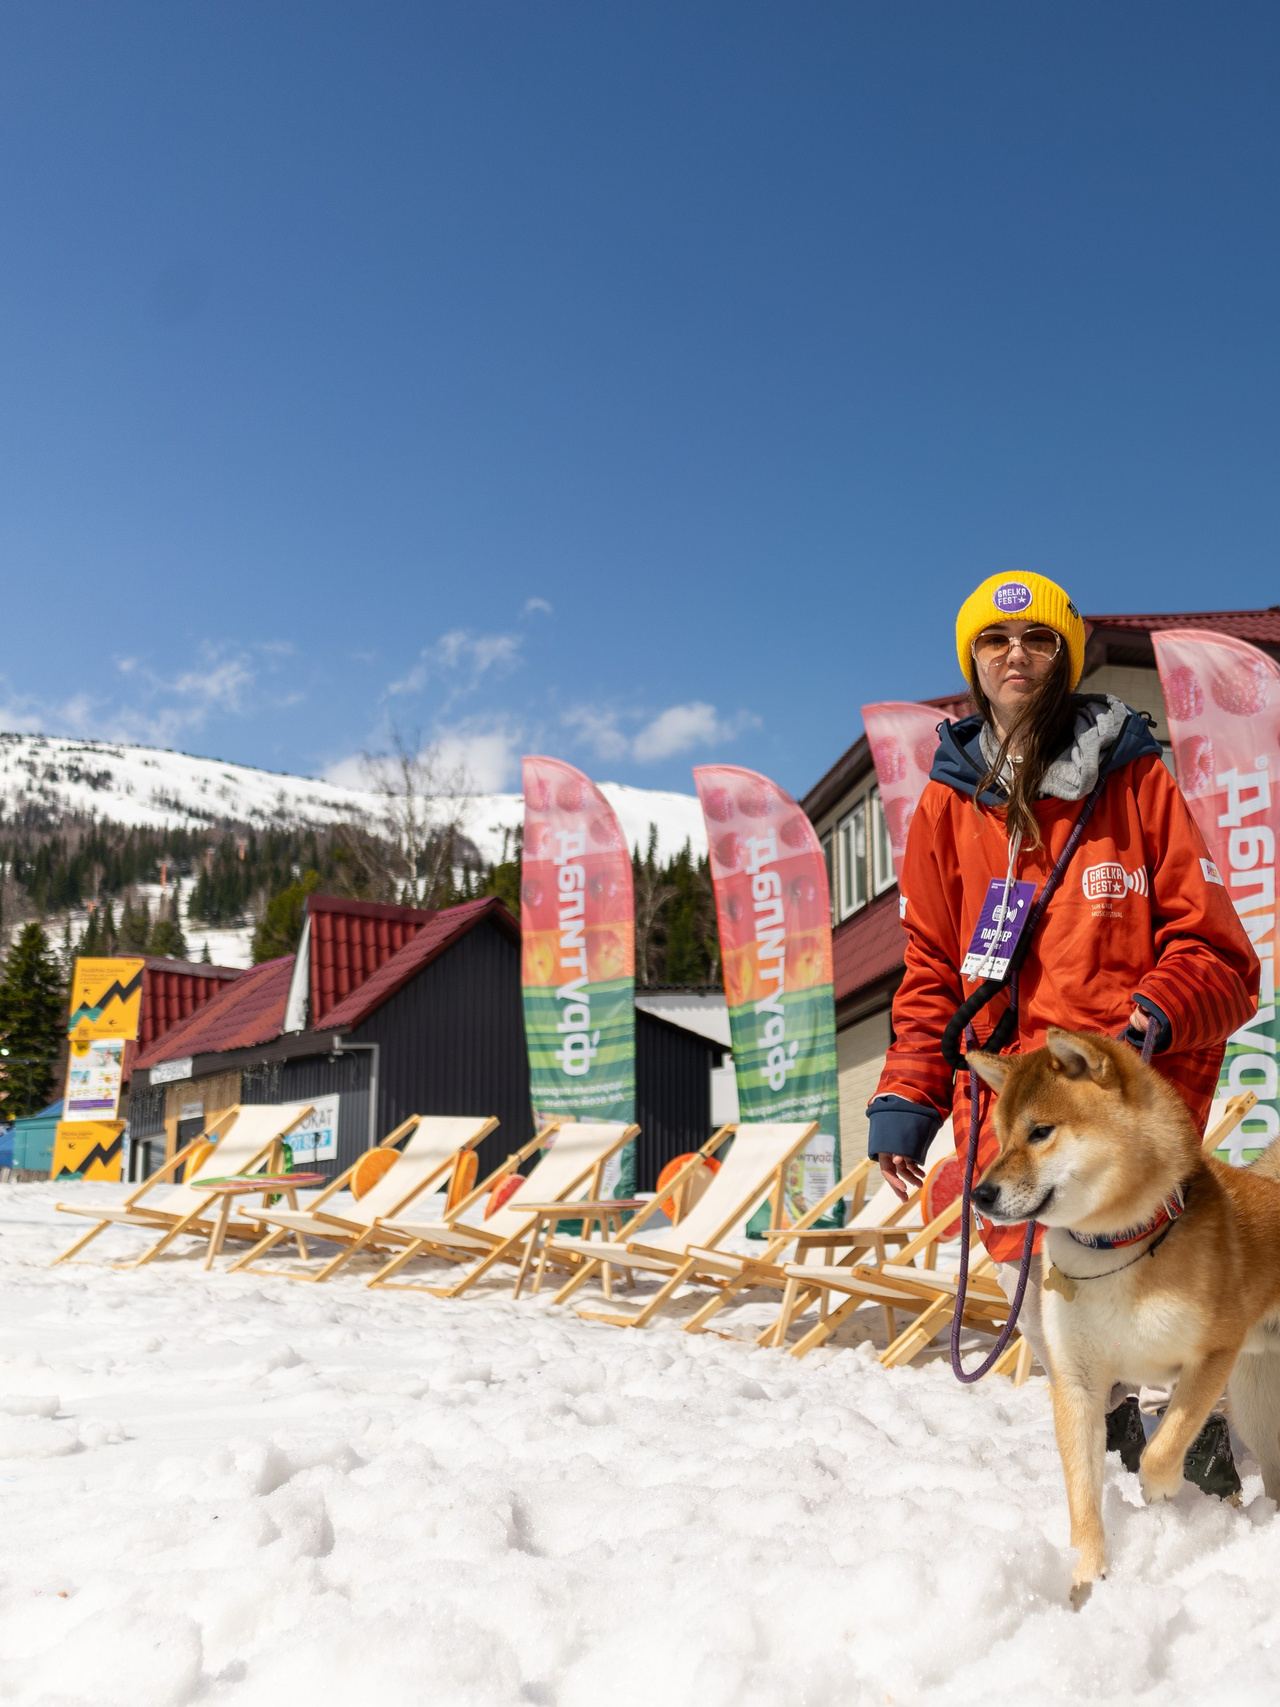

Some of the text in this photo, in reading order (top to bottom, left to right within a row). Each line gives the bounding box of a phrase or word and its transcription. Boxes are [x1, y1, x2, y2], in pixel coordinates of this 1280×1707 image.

[998, 588, 1027, 598] GRELKA
[998, 596, 1018, 606] FEST
[1089, 868, 1122, 882] GRELKA
[1090, 881, 1113, 895] FEST
